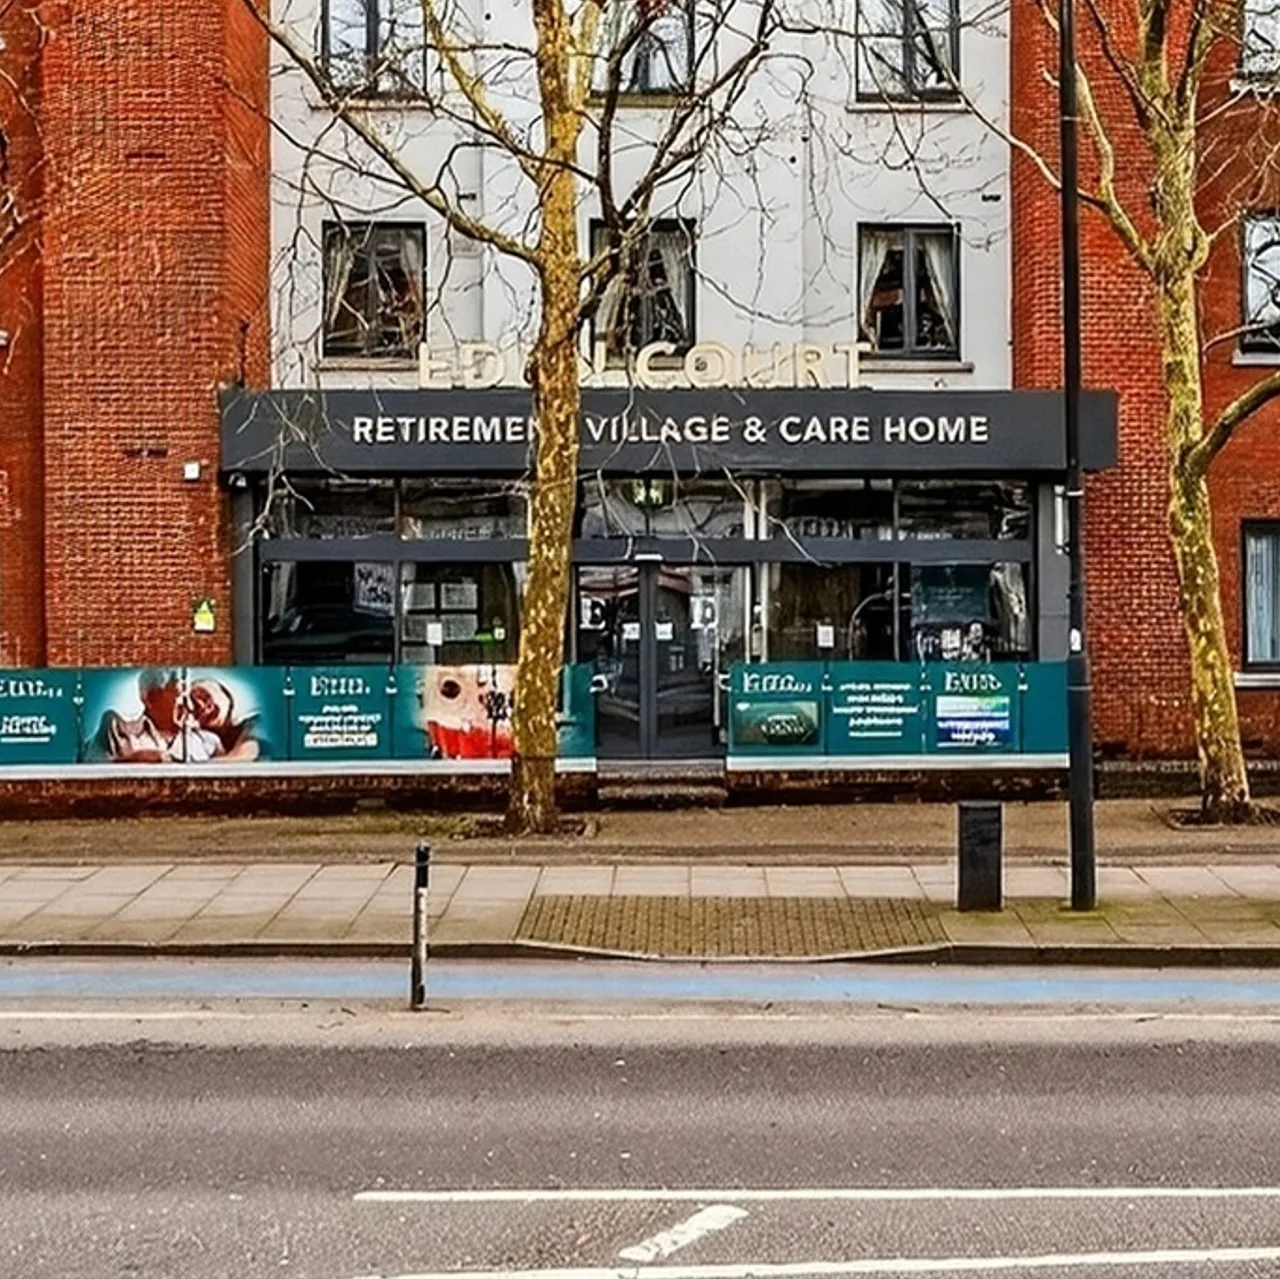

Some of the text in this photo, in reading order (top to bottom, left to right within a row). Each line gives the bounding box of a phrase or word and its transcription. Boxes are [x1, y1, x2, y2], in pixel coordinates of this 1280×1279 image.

[420, 341, 872, 389] EDN COURT
[585, 416, 730, 443] VILLAGE
[743, 417, 767, 443] &
[779, 416, 870, 443] CARE
[884, 416, 989, 443] HOME
